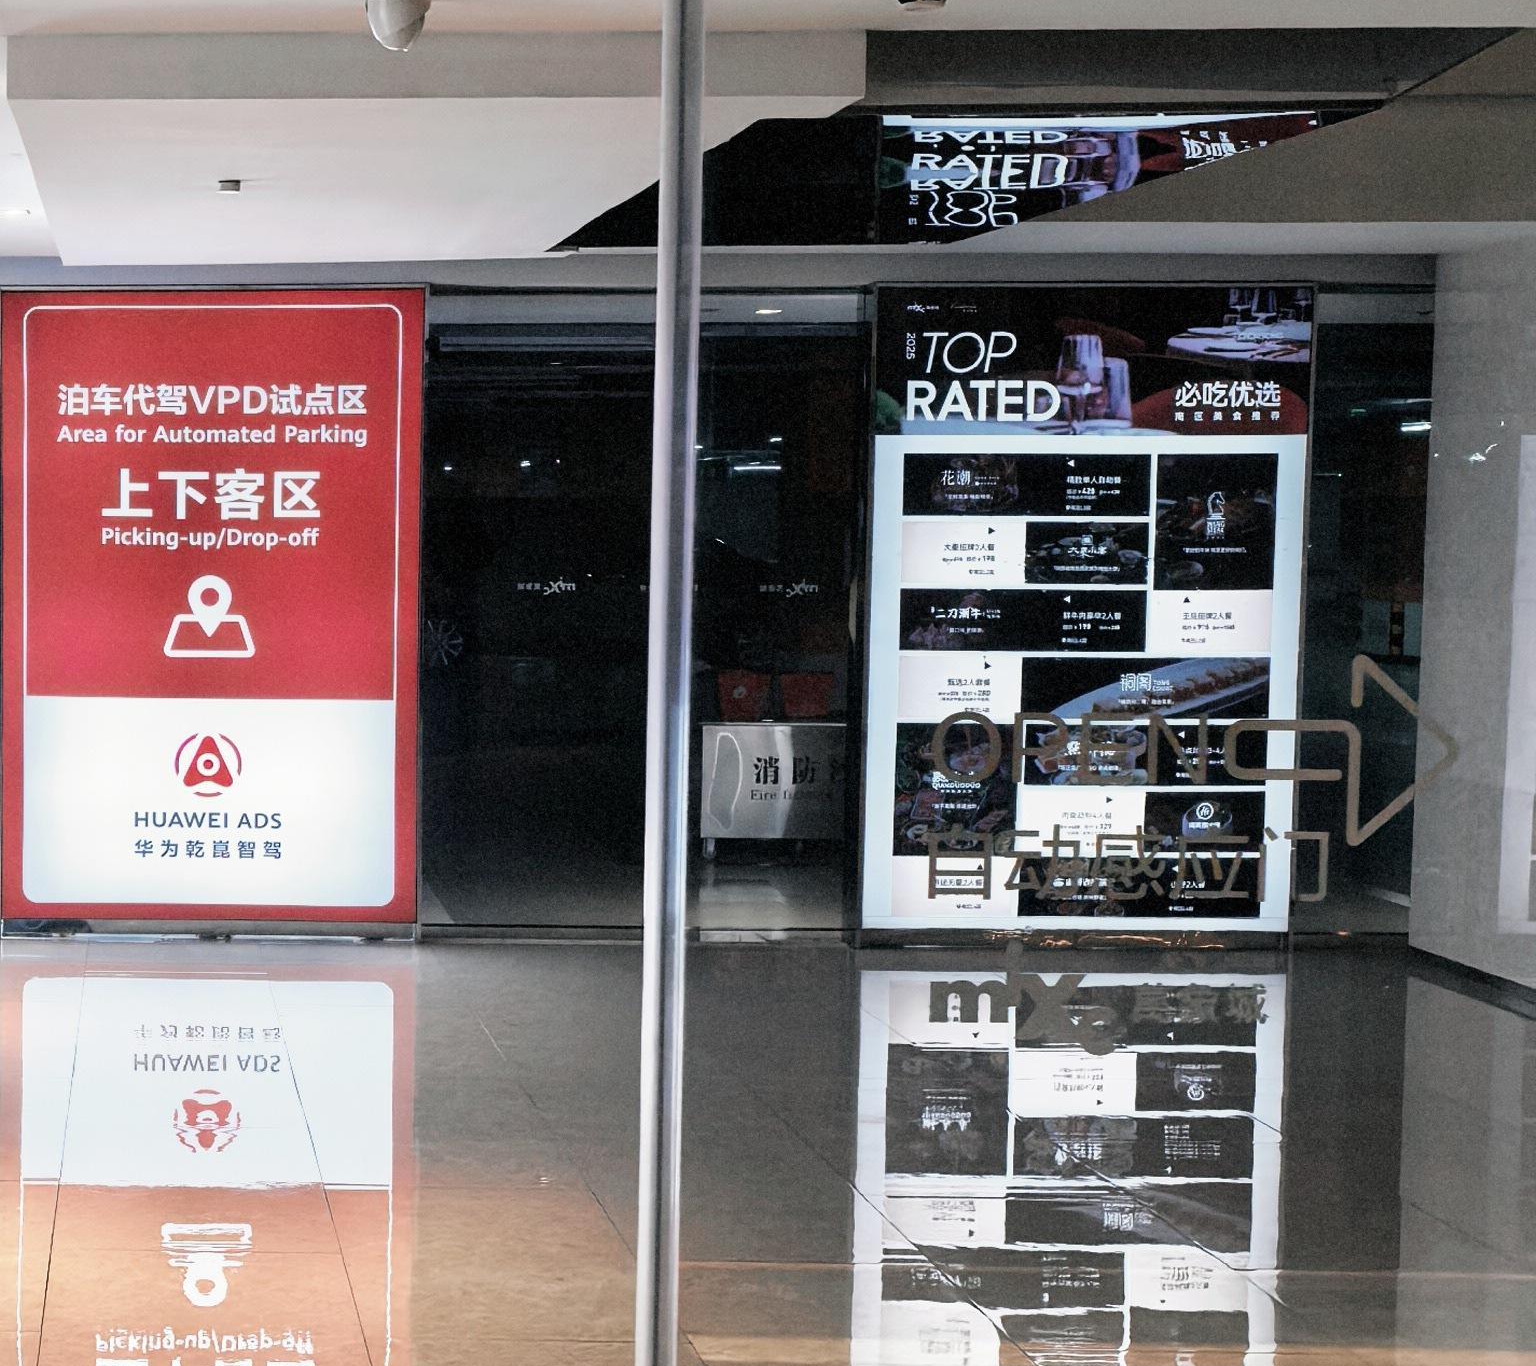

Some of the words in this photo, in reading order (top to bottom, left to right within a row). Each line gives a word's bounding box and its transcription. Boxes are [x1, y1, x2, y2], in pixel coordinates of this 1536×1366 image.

[906, 332, 917, 361] 2025
[923, 331, 1018, 374] TOP
[57, 383, 368, 417] 泊车代驾VPD试点区
[906, 379, 1062, 422] RATED
[1174, 380, 1282, 408] 必吃优选
[57, 426, 107, 444] Area
[115, 425, 145, 444] for
[153, 425, 276, 444] Automated
[284, 425, 368, 448] Parking
[101, 467, 321, 521] 上下客区
[101, 526, 320, 551] Picking-up/Drop-off
[931, 711, 1209, 785] OPEN
[134, 811, 229, 829] HUAWEI
[237, 811, 283, 830] ADS
[925, 823, 1330, 903] 自动感应门
